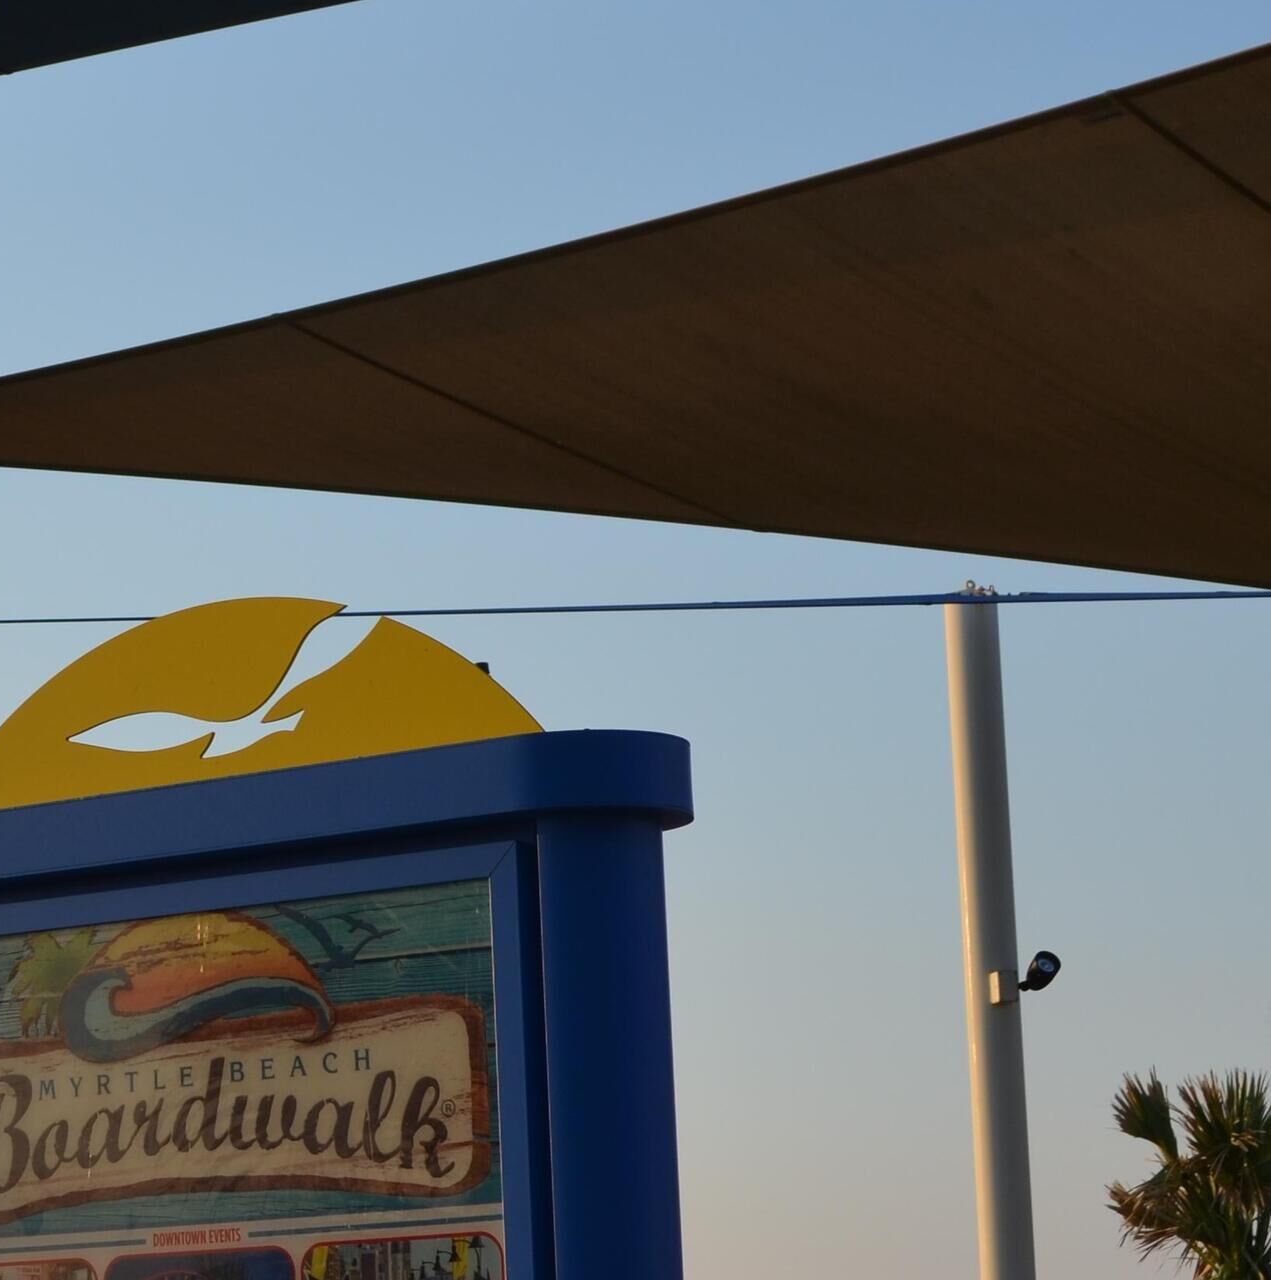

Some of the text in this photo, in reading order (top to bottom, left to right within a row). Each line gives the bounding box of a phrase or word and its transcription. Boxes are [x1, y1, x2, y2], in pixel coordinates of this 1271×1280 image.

[38, 1048, 372, 1100] MYRTLE BEACH
[152, 1227, 241, 1247] DOWNTOWN EVENTS
